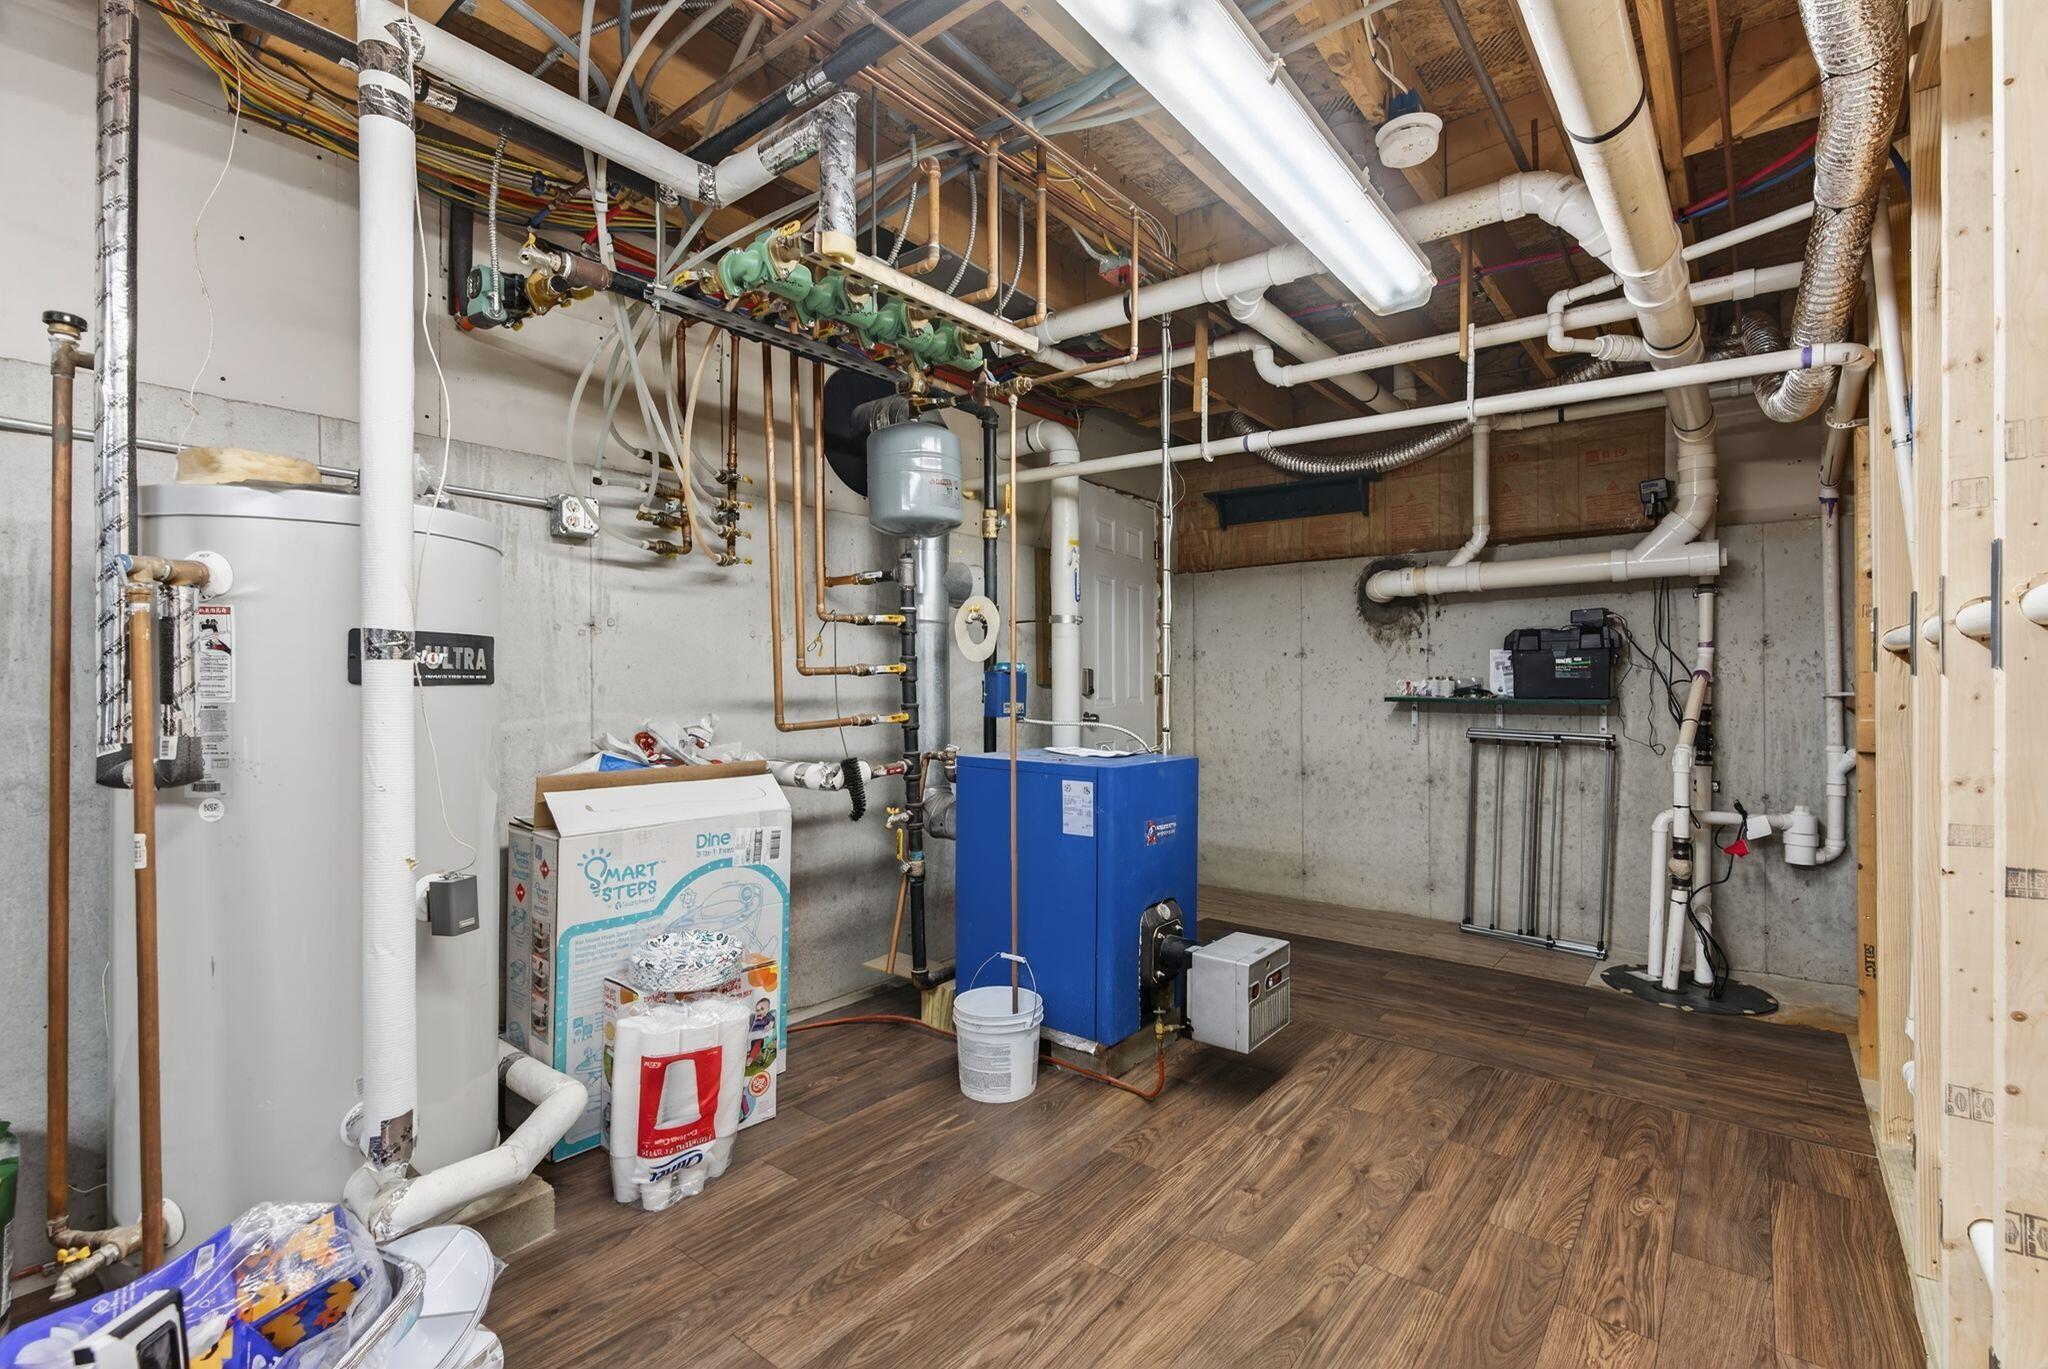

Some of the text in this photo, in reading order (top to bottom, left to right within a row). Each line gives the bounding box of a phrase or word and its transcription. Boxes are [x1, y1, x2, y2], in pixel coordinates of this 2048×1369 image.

[425, 645, 487, 670] ULTRA
[696, 832, 731, 849] Dine
[602, 880, 657, 902] STEPS
